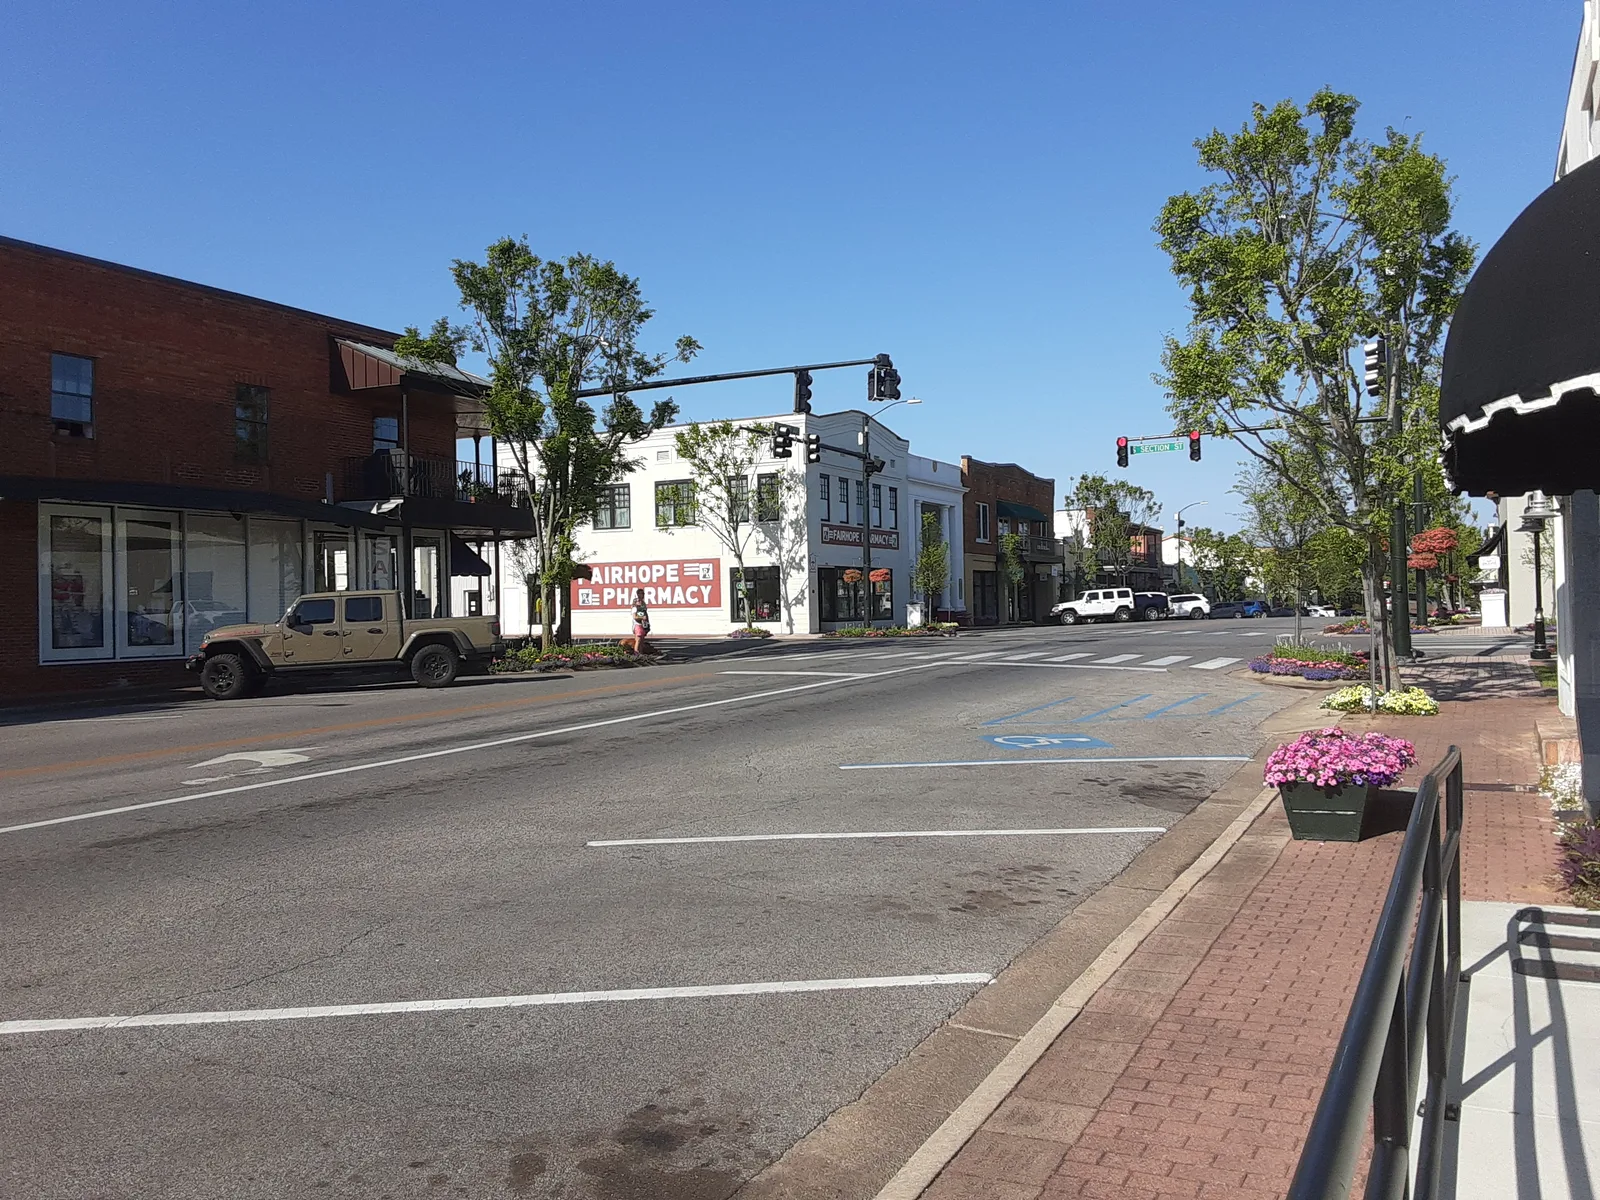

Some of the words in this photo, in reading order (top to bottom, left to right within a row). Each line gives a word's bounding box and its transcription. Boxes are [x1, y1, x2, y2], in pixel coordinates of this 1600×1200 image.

[1140, 444, 1170, 453] SECTION
[1174, 442, 1183, 450] ST
[833, 529, 860, 543] FAIRHOPE
[577, 563, 680, 585] AIRHOPE
[602, 585, 713, 606] PHARMACY
